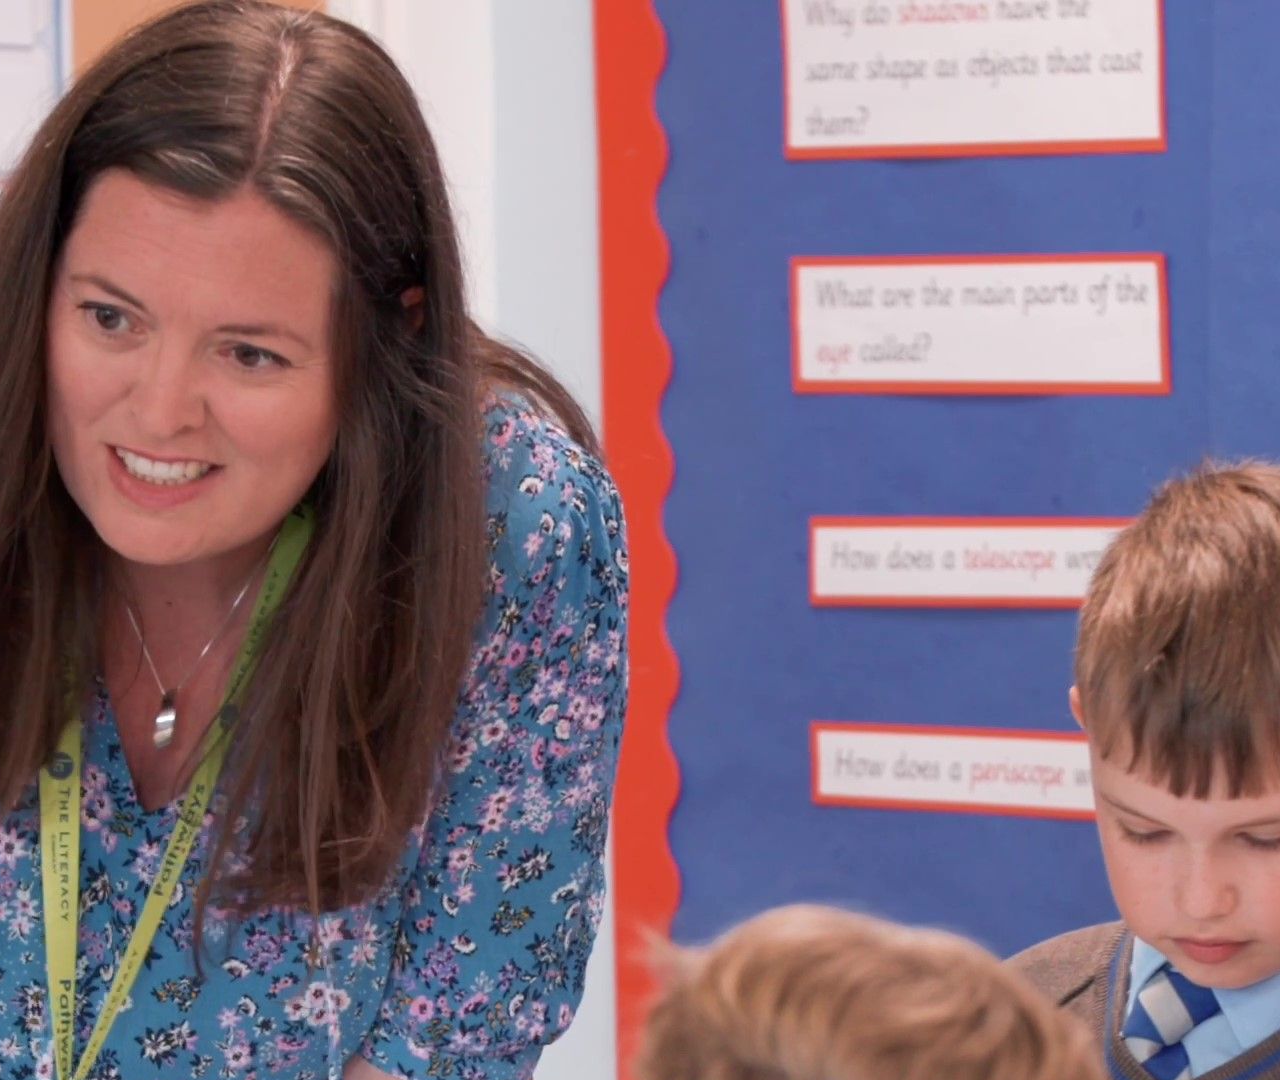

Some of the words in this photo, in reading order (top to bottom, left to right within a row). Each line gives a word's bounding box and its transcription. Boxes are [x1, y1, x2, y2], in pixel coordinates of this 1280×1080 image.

[803, 0, 856, 37] Why
[862, 0, 892, 25] do
[804, 60, 858, 83] same
[864, 55, 927, 89] shape
[933, 58, 960, 78] as
[966, 51, 1039, 88] objects
[1045, 48, 1092, 75] that
[1098, 50, 1144, 75] cast
[805, 104, 870, 137] them?
[815, 279, 875, 310] What
[881, 285, 915, 309] are
[920, 276, 953, 309] the
[960, 284, 1017, 307] main
[1020, 282, 1081, 316] parts
[1086, 273, 1112, 316] of
[1115, 273, 1148, 306] the
[815, 344, 854, 375] eye
[858, 331, 934, 364] called?
[829, 540, 879, 571] How
[884, 540, 935, 571] does
[941, 550, 957, 571] a
[962, 541, 1058, 582] telescope
[833, 747, 884, 780] How
[890, 751, 942, 782] does
[947, 761, 963, 782] a
[969, 760, 1066, 798] periscope
[58, 786, 71, 824] THE
[57, 831, 71, 921] LITERACY
